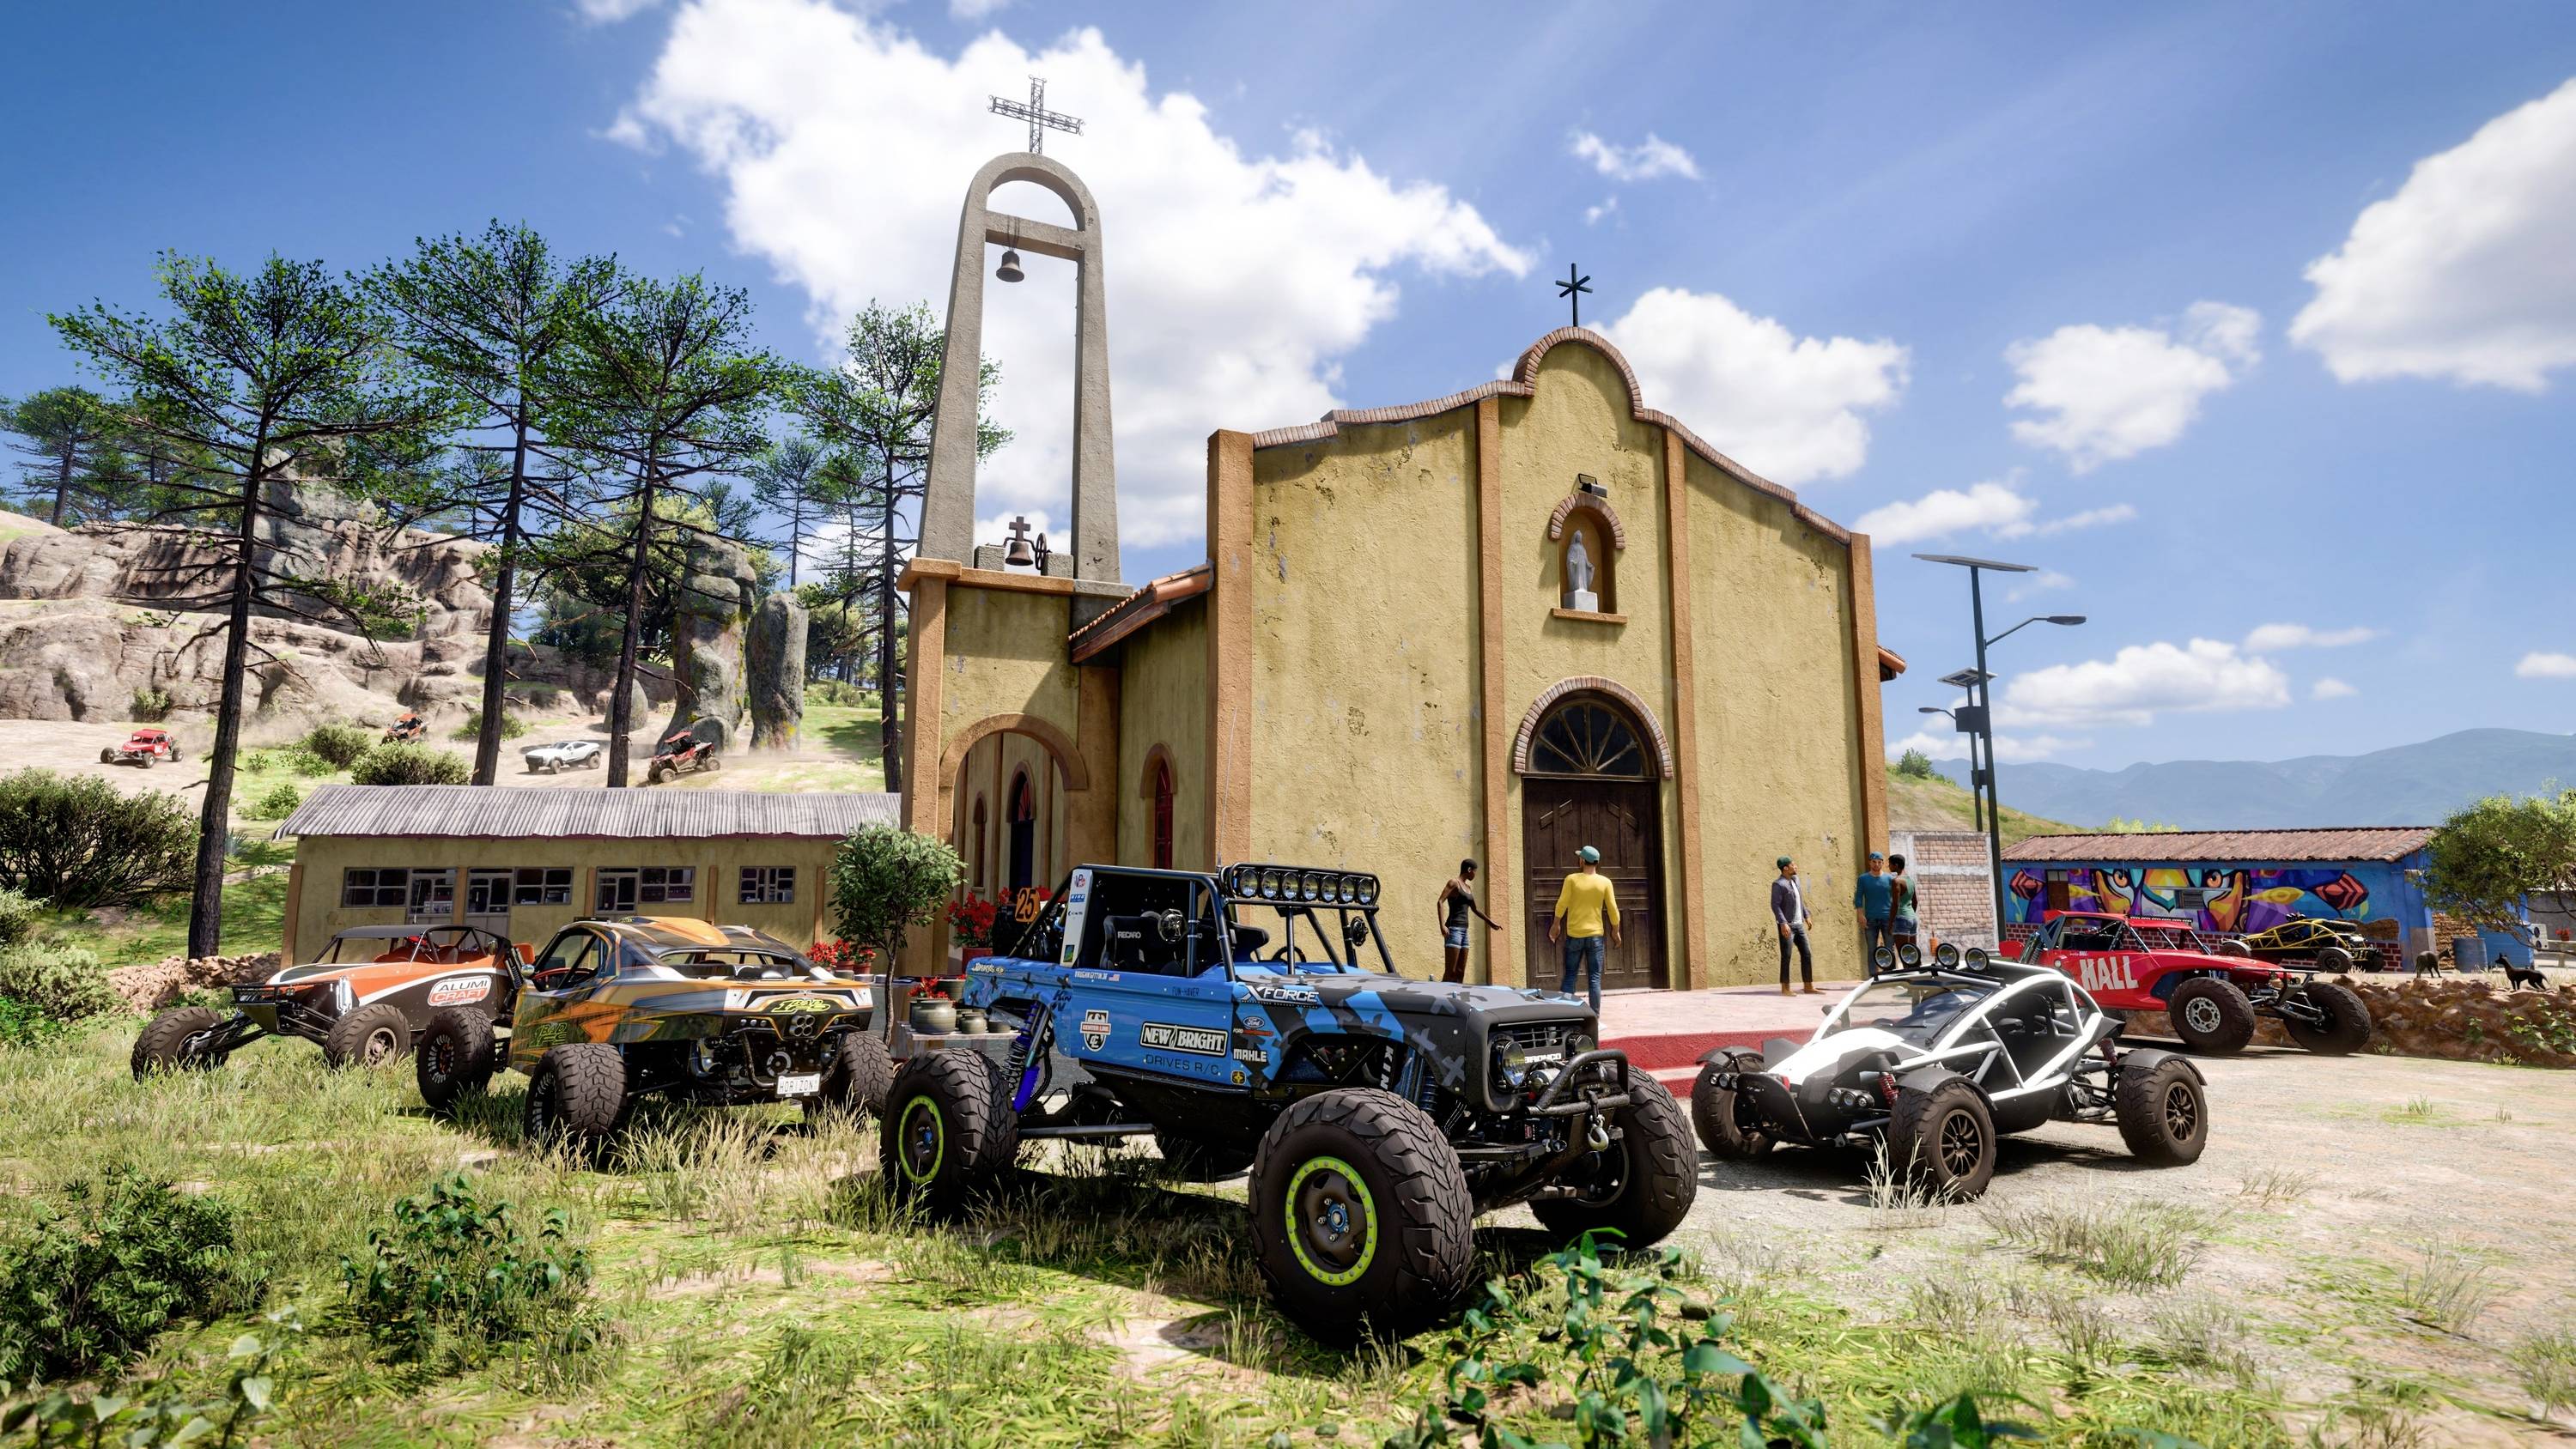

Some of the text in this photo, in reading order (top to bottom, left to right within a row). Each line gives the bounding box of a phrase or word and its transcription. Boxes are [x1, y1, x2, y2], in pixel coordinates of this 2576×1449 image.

[1017, 889, 1037, 920] 25
[1117, 931, 1142, 939] RECARO
[2079, 955, 2139, 991] HALL
[439, 979, 488, 991] ALUMI
[434, 989, 484, 1002] CRAFT
[1247, 1016, 1261, 1026] Ford
[1143, 1027, 1224, 1052] NEW BRIGHT
[1145, 1054, 1190, 1071] DRIVES
[1233, 1048, 1267, 1063] MAHLE
[779, 1079, 813, 1094] HORIZON
